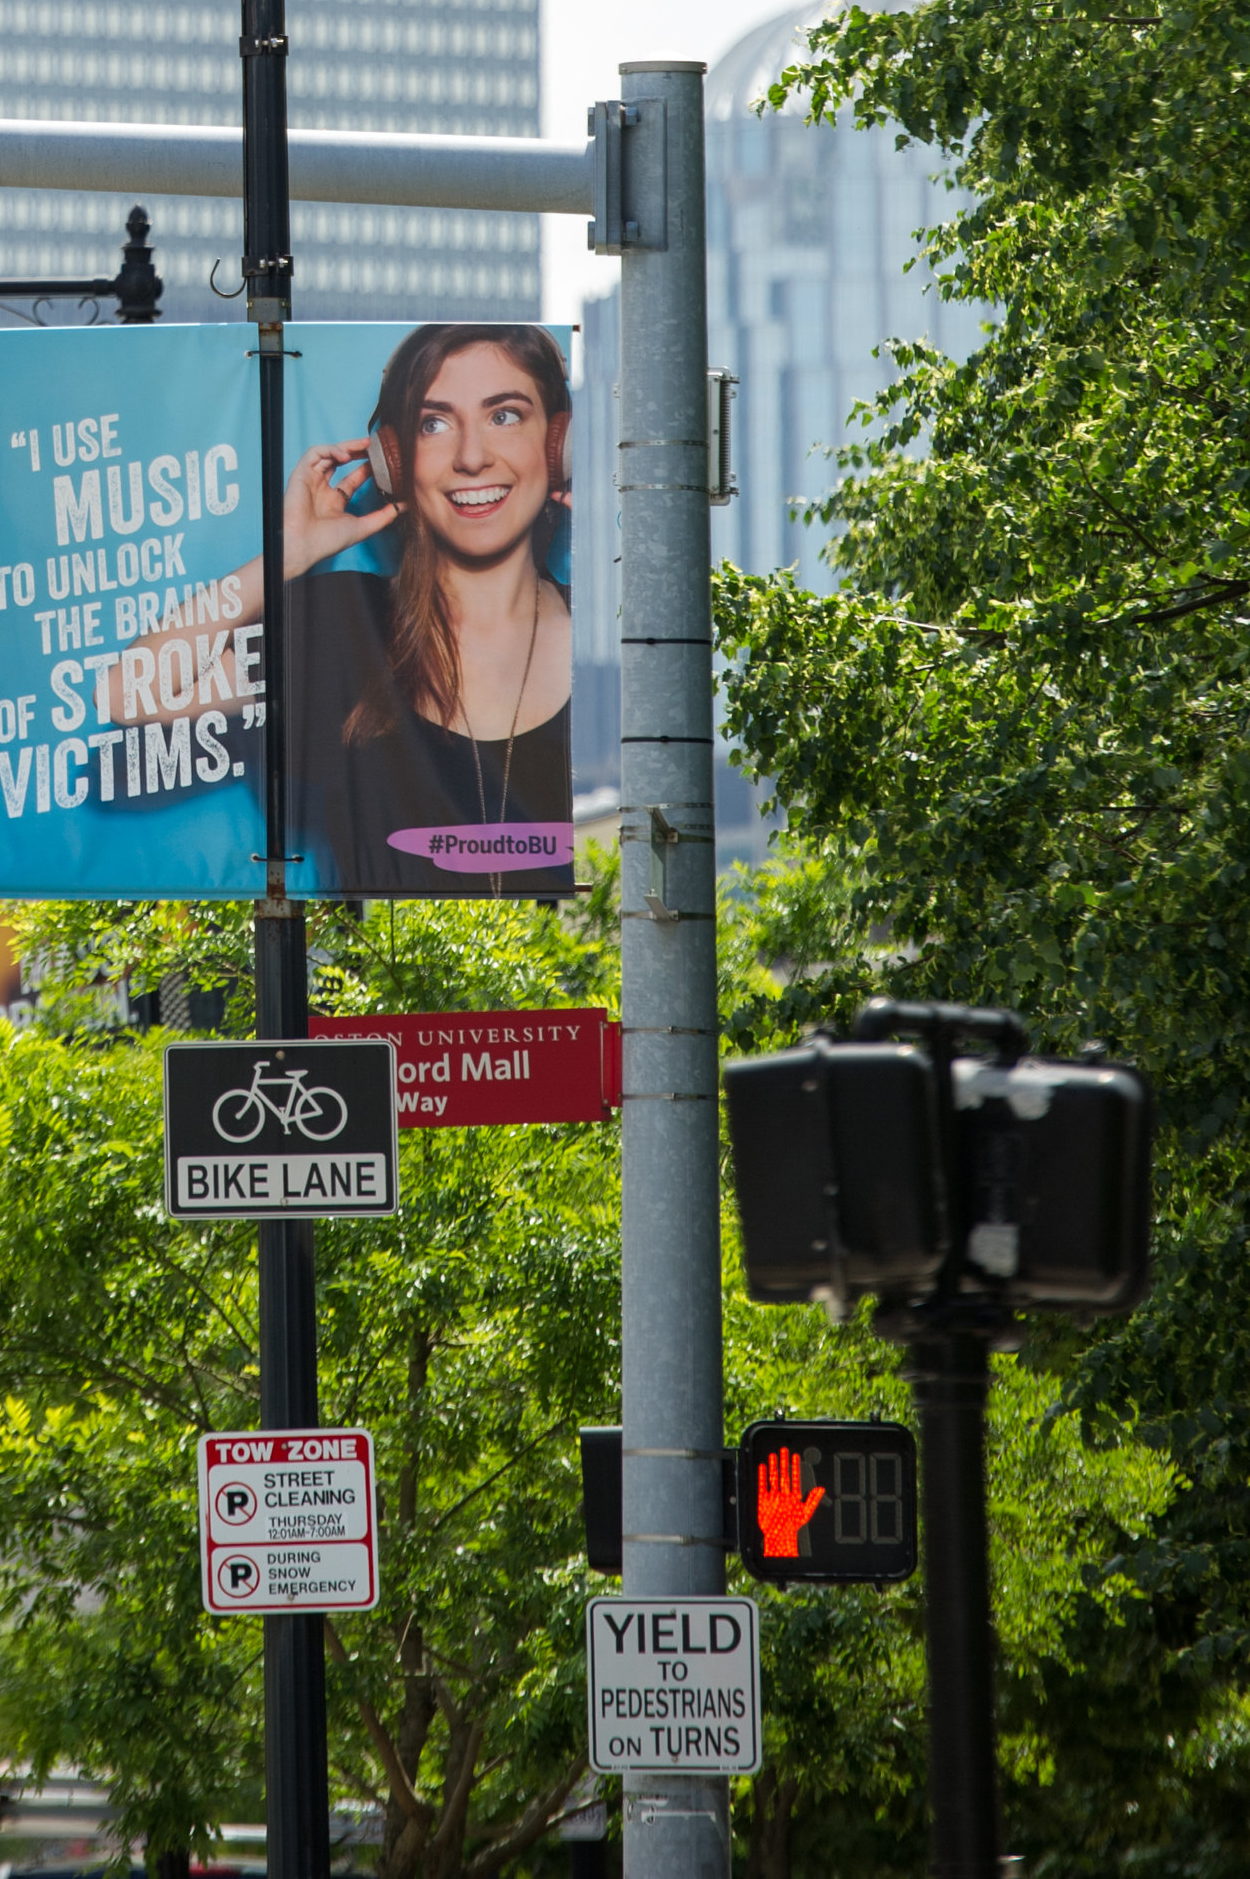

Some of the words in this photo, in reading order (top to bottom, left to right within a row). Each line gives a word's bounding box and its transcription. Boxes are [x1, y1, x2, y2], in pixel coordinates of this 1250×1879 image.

[52, 413, 122, 467] USE
[53, 444, 239, 546] MUSIC
[46, 532, 187, 600] UNLOCK
[34, 602, 105, 655] THE
[115, 575, 243, 641] BRAINS
[50, 623, 267, 732] STROKE
[428, 834, 557, 856] #ProudtoBU
[418, 1025, 581, 1046] UNIVERSITY
[461, 1049, 530, 1082] Mall
[396, 1091, 448, 1117] Way
[187, 1163, 270, 1200] BIKE
[283, 1161, 377, 1198] LANE
[215, 1442, 272, 1463] TOW
[286, 1439, 356, 1460] ZONE
[263, 1470, 335, 1488] STREET
[264, 1489, 355, 1508] CLEANING
[269, 1514, 342, 1527] THURSDAY
[267, 1551, 321, 1565] DURING
[268, 1567, 311, 1580] SNOW
[268, 1580, 357, 1596] EMERGENCY
[603, 1613, 742, 1655] YIELD
[656, 1661, 688, 1681] TO
[601, 1688, 746, 1719] PEDESTRIANS
[609, 1736, 642, 1757] ON
[650, 1726, 740, 1757] TURNS
